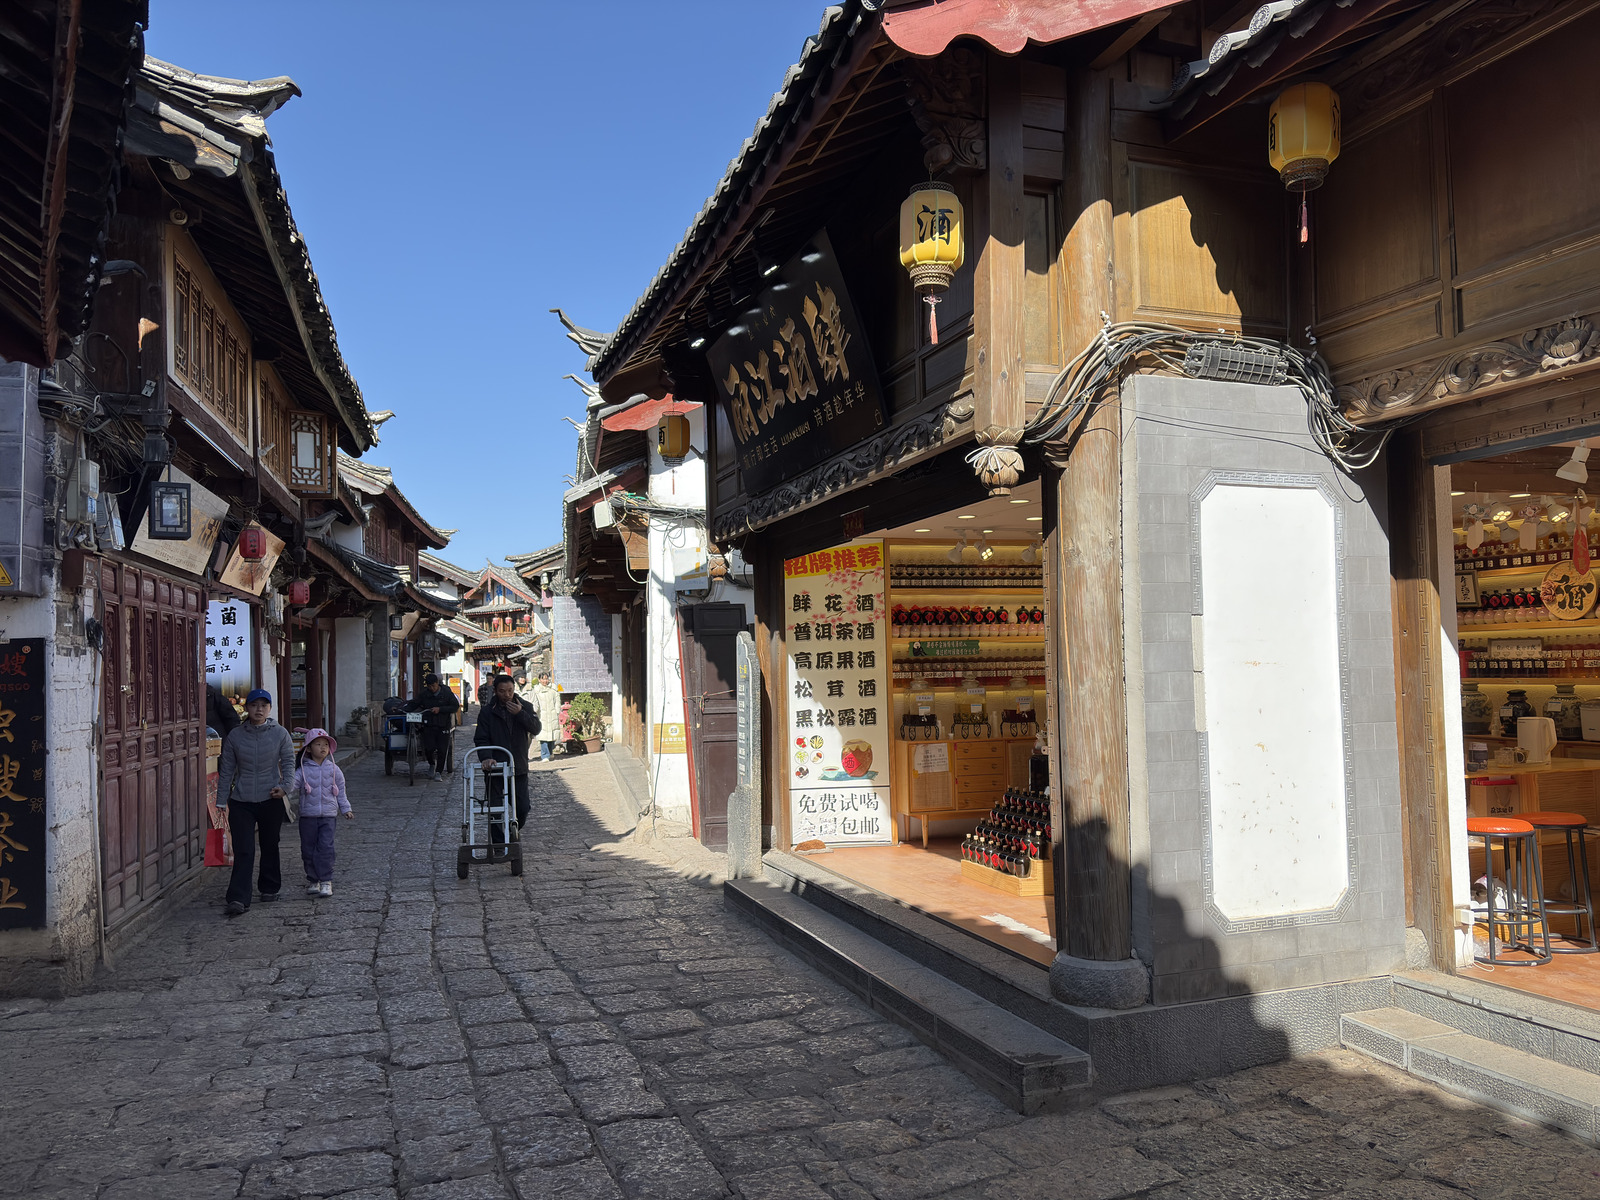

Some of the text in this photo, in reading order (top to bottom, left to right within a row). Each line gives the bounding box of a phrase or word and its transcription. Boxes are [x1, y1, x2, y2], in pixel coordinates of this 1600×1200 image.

[917, 204, 954, 246] 酒
[743, 436, 779, 470] 旅行即生活
[813, 380, 866, 427] 诗酒趁年华
[784, 546, 881, 576] 招牌推荐
[1554, 574, 1594, 611] 酒
[794, 622, 875, 641] 普洱茶酒
[794, 650, 876, 670] 高原果酒
[796, 707, 877, 728] 黑松露酒
[798, 792, 879, 815] 免费试喝
